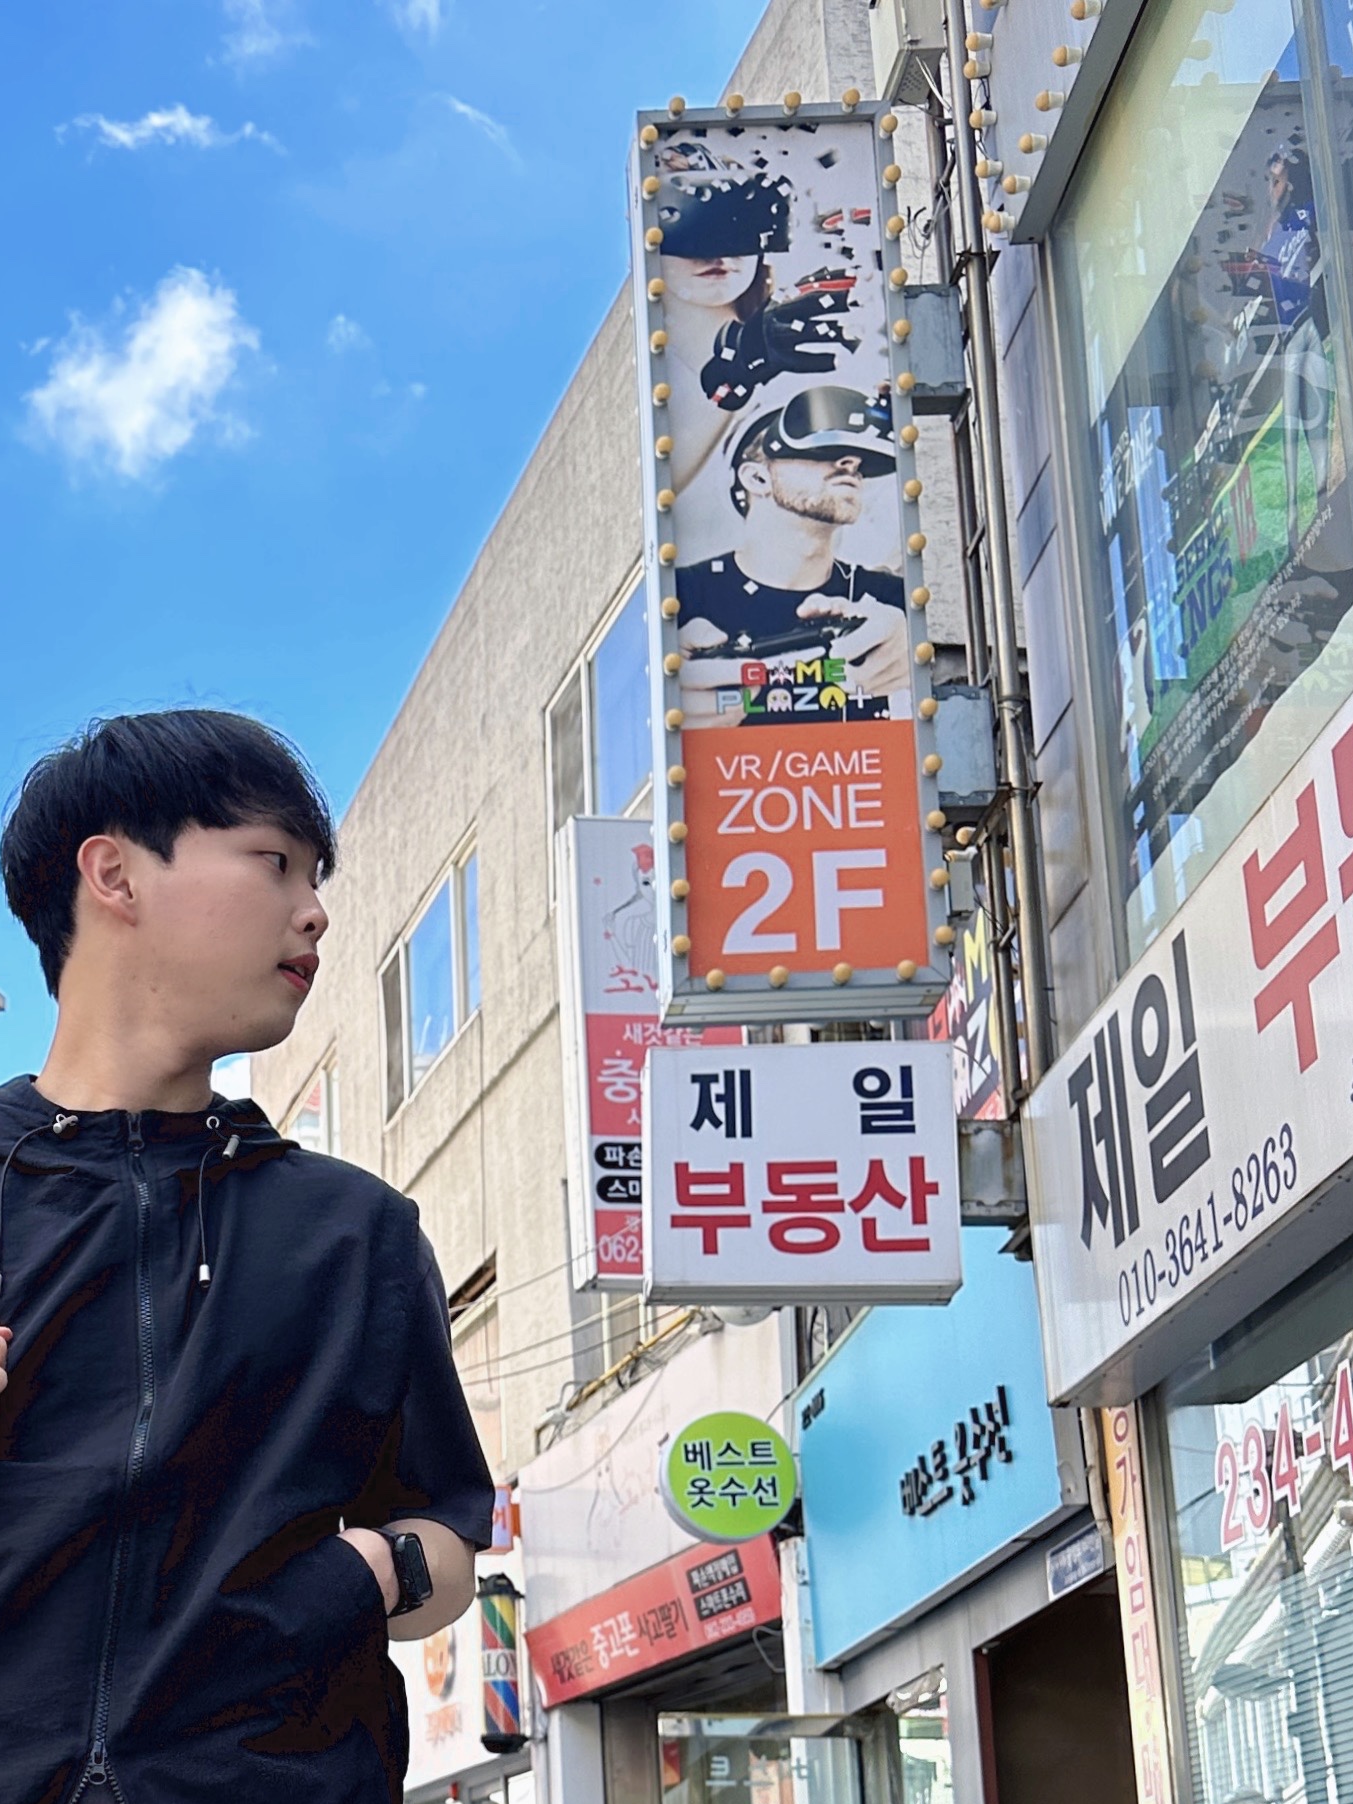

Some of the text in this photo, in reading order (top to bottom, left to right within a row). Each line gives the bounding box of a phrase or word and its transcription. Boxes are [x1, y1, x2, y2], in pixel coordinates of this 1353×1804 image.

[717, 782, 885, 835] ZONE
[721, 848, 887, 955] 2F
[1068, 929, 1212, 1252] 제일
[1242, 724, 1353, 1075] 부
[670, 1155, 940, 1255] 부동산
[1116, 1122, 1298, 1328] 010-3641-8263
[683, 1440, 777, 1472] 베스트
[686, 1476, 779, 1509] 옷수선
[900, 1439, 954, 1517] 베스트
[589, 1610, 641, 1671] 중고폰
